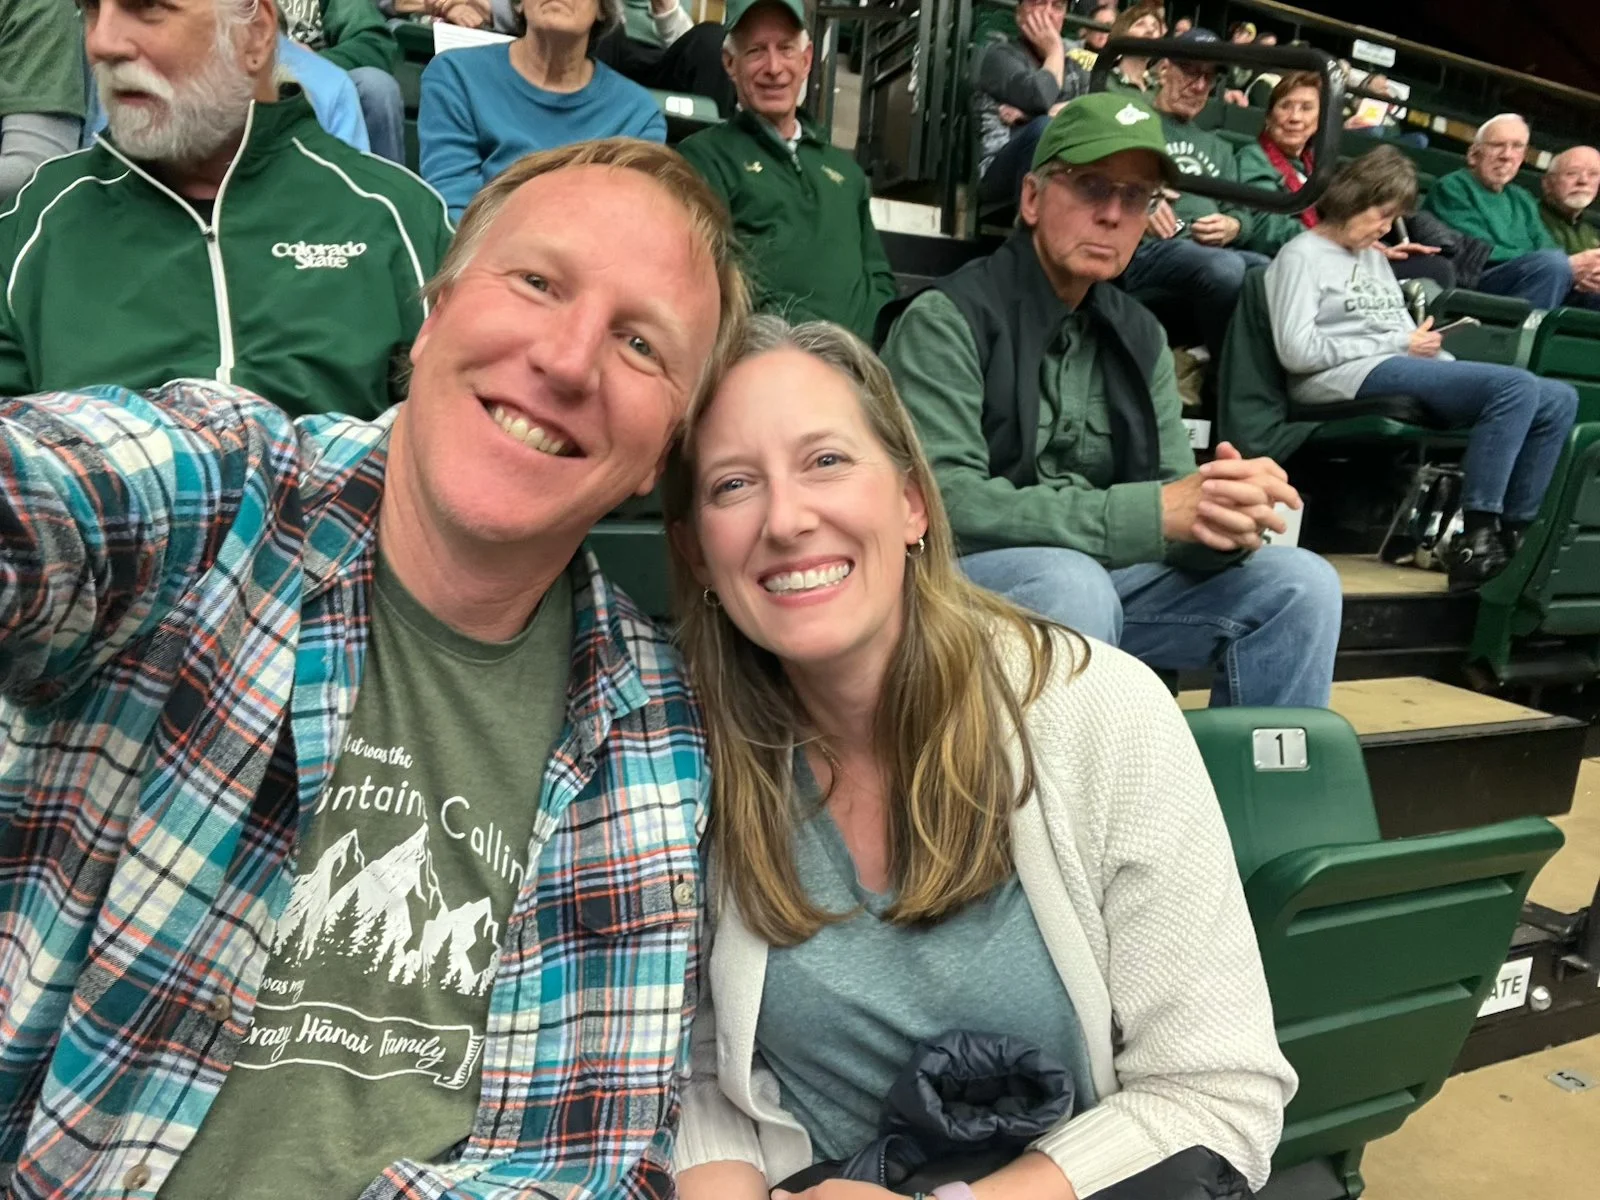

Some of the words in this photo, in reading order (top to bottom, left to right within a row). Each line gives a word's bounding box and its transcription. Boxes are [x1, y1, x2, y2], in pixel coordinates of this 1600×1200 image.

[271, 240, 367, 258] Colorado
[294, 253, 349, 270] State
[363, 743, 389, 764] was
[388, 745, 414, 769] the
[1274, 732, 1285, 766] 1
[440, 795, 526, 892] Callin
[1487, 974, 1524, 1001] ATE
[295, 1012, 375, 1055] Hānai
[379, 1029, 447, 1069] Family
